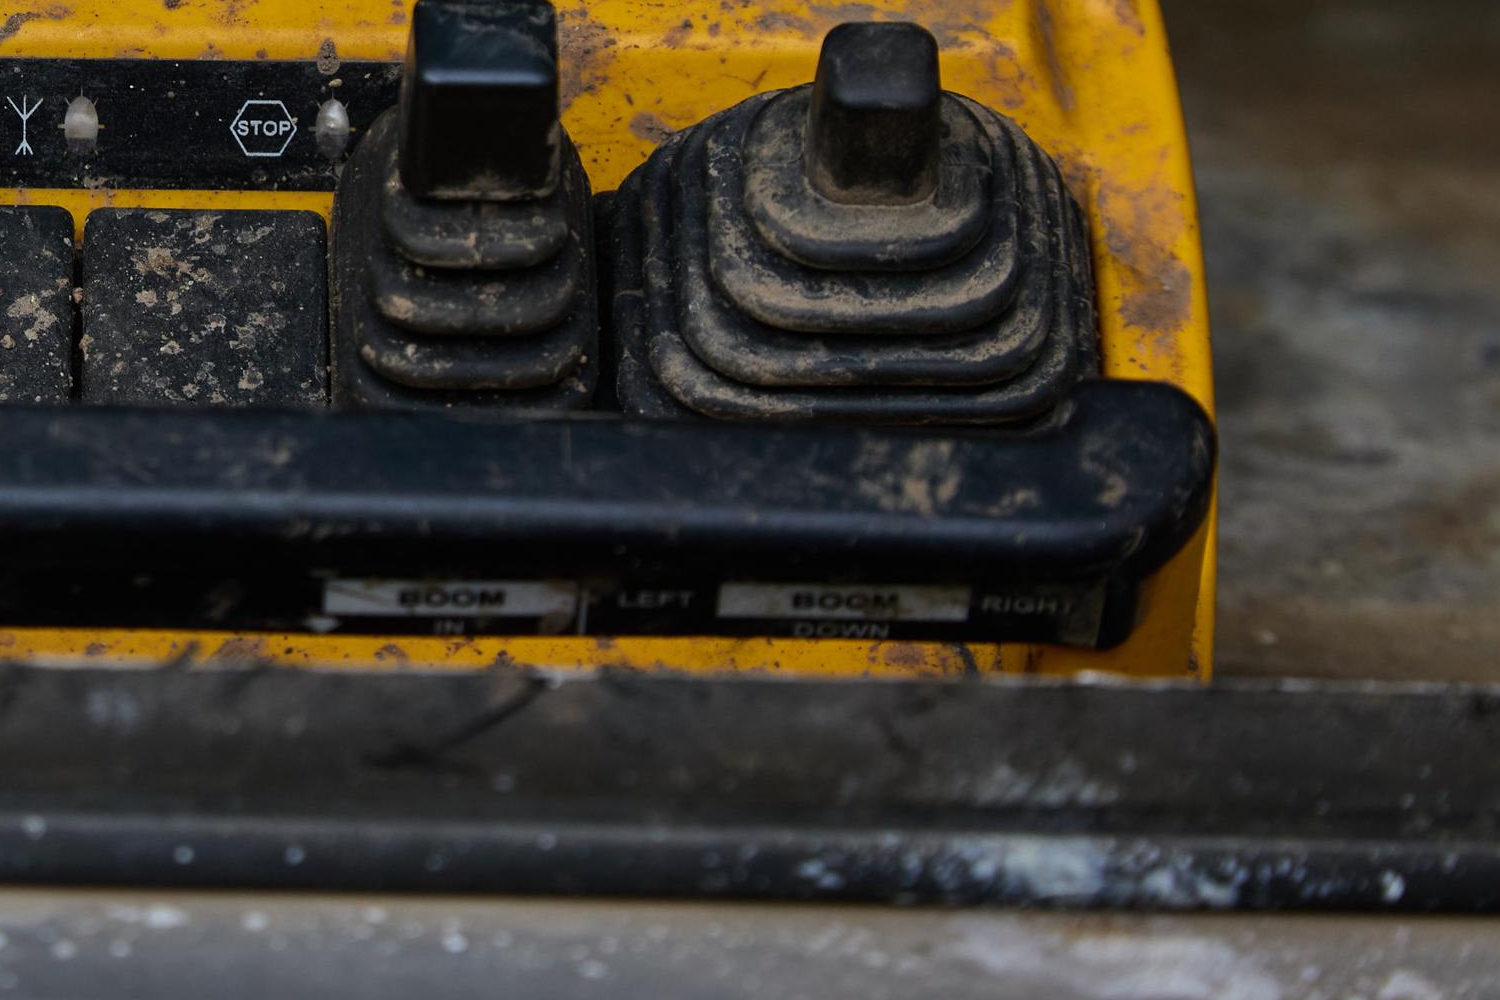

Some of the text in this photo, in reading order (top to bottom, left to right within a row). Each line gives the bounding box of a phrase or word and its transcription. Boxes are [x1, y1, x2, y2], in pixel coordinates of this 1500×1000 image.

[236, 119, 292, 137] STOP
[399, 589, 506, 607] BOOM
[614, 589, 697, 608] LEFT
[792, 592, 897, 611] BOOM
[980, 592, 1074, 615] RIGHT
[433, 618, 466, 635] IN
[793, 621, 892, 639] DOWN
